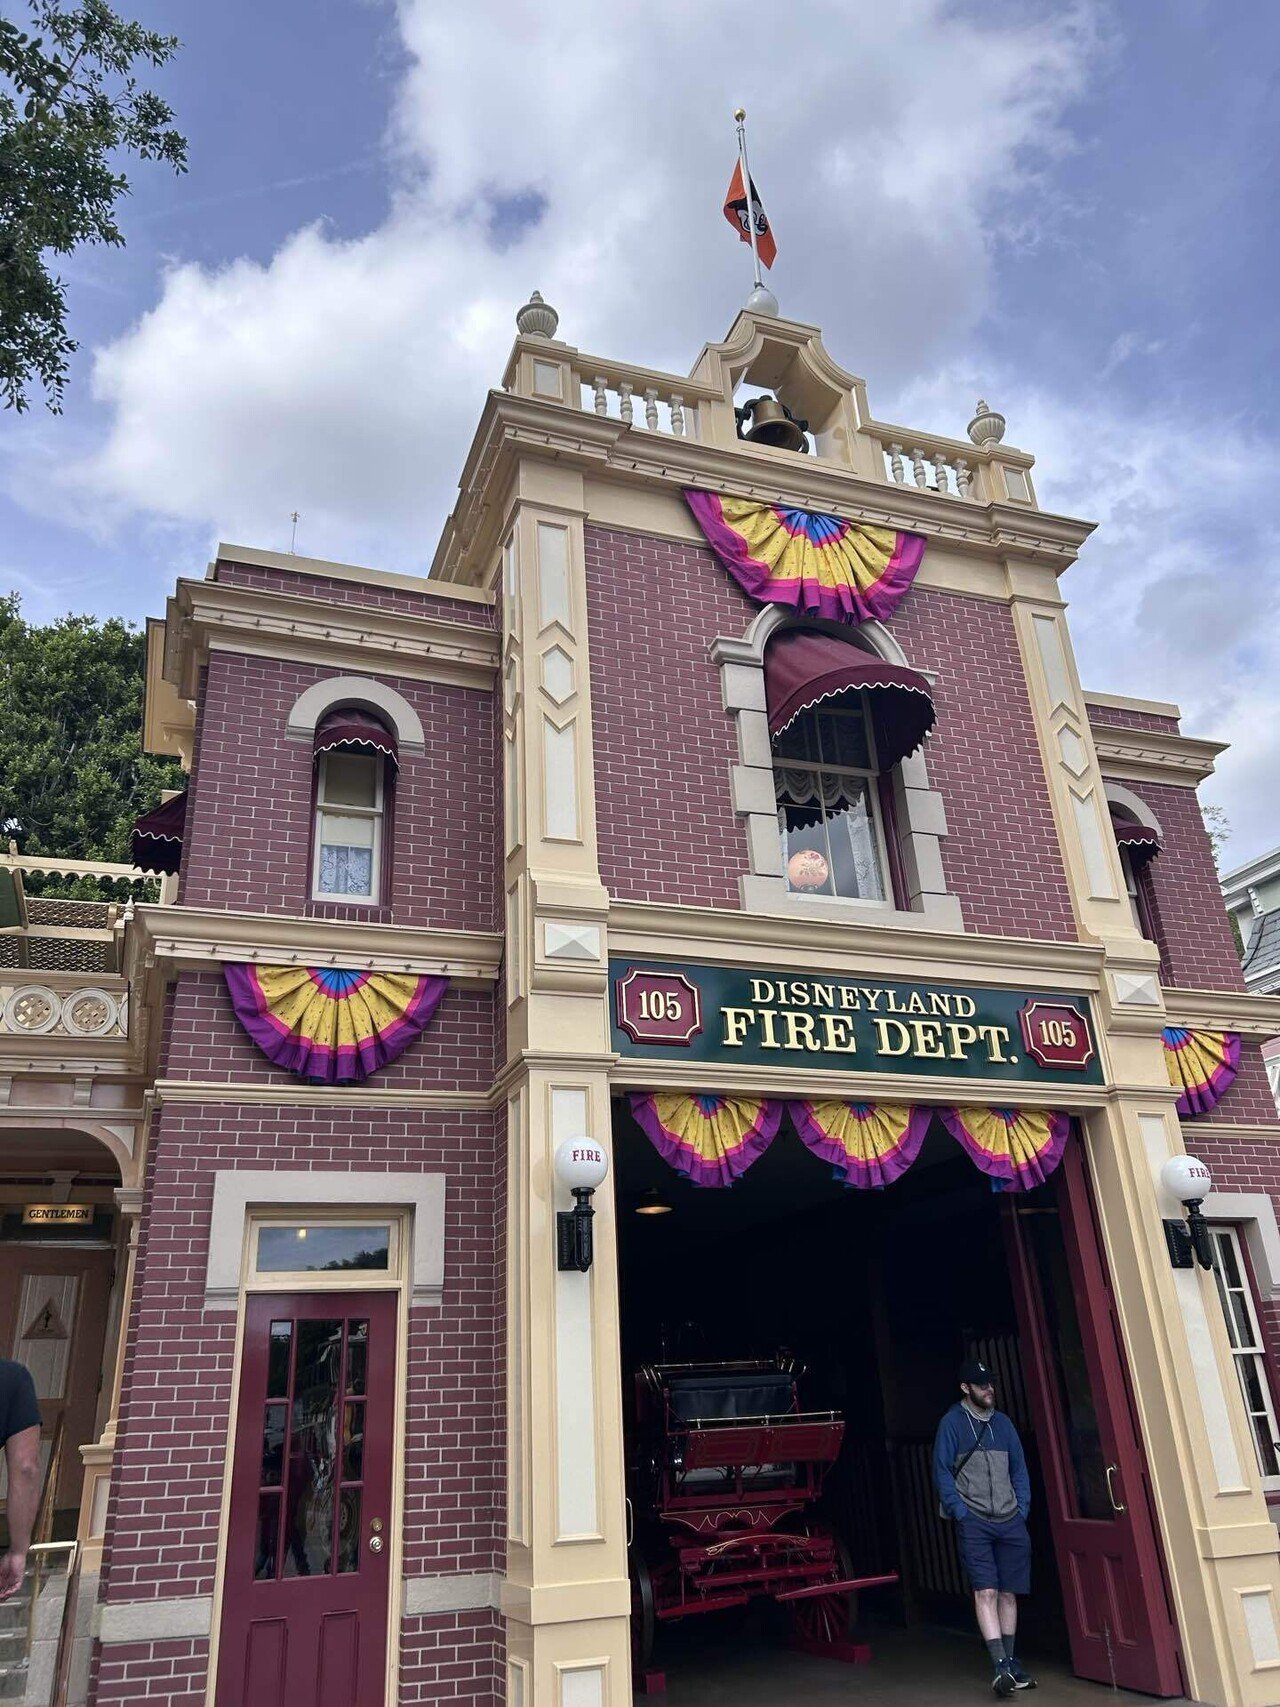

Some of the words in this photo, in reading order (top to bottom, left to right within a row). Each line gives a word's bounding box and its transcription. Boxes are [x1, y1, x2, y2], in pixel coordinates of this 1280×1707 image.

[638, 989, 683, 1021] 105
[750, 979, 976, 1018] DISNEYLAND
[720, 1006, 857, 1054] FIRE
[873, 1017, 1019, 1064] DEPT.
[1037, 1020, 1077, 1049] 105
[572, 1149, 601, 1162] FIRE
[28, 1208, 89, 1219] GENTLEMEN
